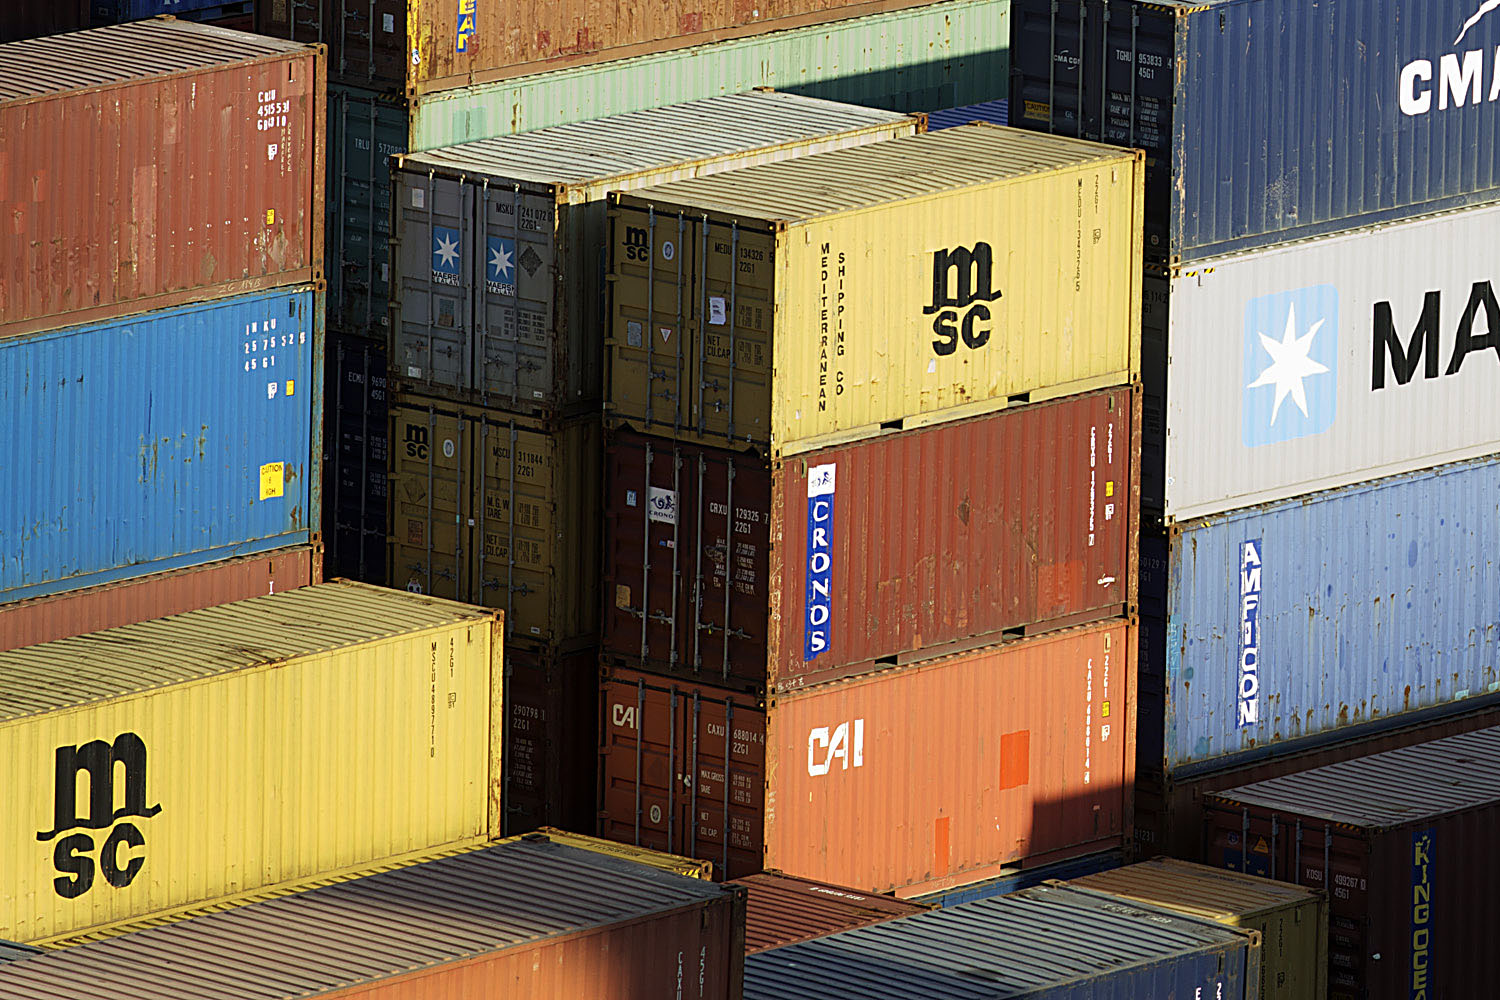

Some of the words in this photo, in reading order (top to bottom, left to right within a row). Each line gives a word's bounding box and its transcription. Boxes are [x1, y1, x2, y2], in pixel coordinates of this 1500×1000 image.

[1054, 54, 1068, 64] CMA
[1116, 49, 1132, 62] TGHU
[1138, 53, 1163, 68] 953833
[1138, 67, 1155, 80] 45G1
[354, 138, 370, 152] TRLU
[495, 203, 513, 216] MSKU
[522, 206, 547, 221] 241072
[521, 218, 537, 231] 22G1
[714, 242, 732, 255] MEDU
[740, 247, 764, 263] 134326
[739, 261, 755, 274] 22G1
[836, 252, 846, 357] SHIPPING
[818, 243, 830, 412] MEDITERRANEAN
[244, 355, 274, 372] 45G1
[836, 370, 845, 396] CO
[493, 446, 510, 459] MSCU
[517, 464, 534, 478] 22G1
[486, 507, 501, 520] TARE
[709, 502, 727, 516] CRXU
[735, 507, 759, 523] 129325
[734, 521, 751, 535] 22G1
[810, 500, 831, 652] CRONOS
[1238, 542, 1261, 726] AMFICON
[513, 704, 539, 720] 290798
[613, 704, 639, 729] CAI
[513, 717, 530, 732] 22G1
[707, 723, 725, 737] CAXU
[733, 727, 758, 743] 688014
[732, 741, 749, 755] 22G1
[807, 719, 865, 776] CAI
[1306, 867, 1323, 881] KOSU
[1333, 873, 1358, 889] 499267
[1412, 847, 1430, 926] KING
[1332, 886, 1350, 900] 45G1
